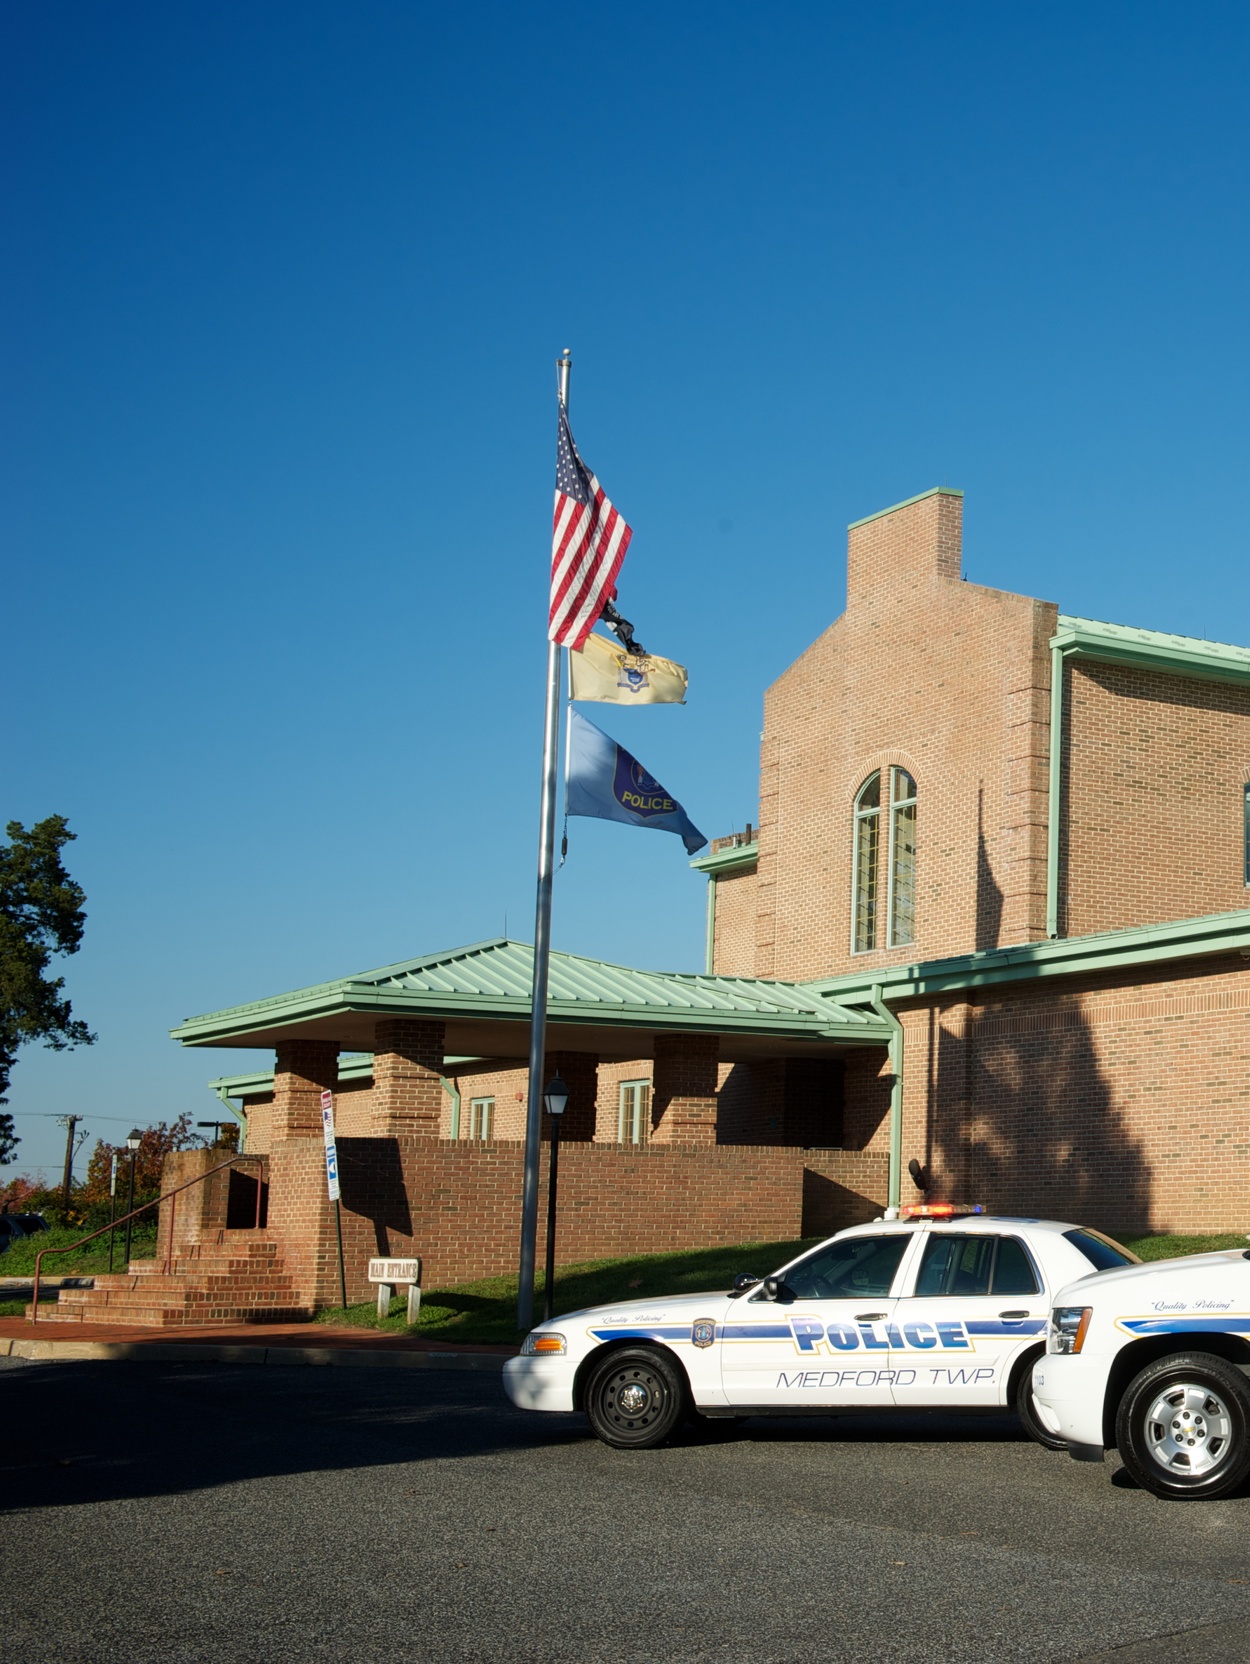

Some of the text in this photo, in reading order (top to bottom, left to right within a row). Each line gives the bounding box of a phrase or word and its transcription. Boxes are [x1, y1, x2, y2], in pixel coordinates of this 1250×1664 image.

[621, 791, 673, 810] POLICE
[370, 1263, 417, 1279] MAIN ENTRANCE
[1151, 1299, 1235, 1311] "Quality Policing"
[791, 1317, 970, 1351] POLICE
[776, 1368, 996, 1389] MEDFORD TWP.
